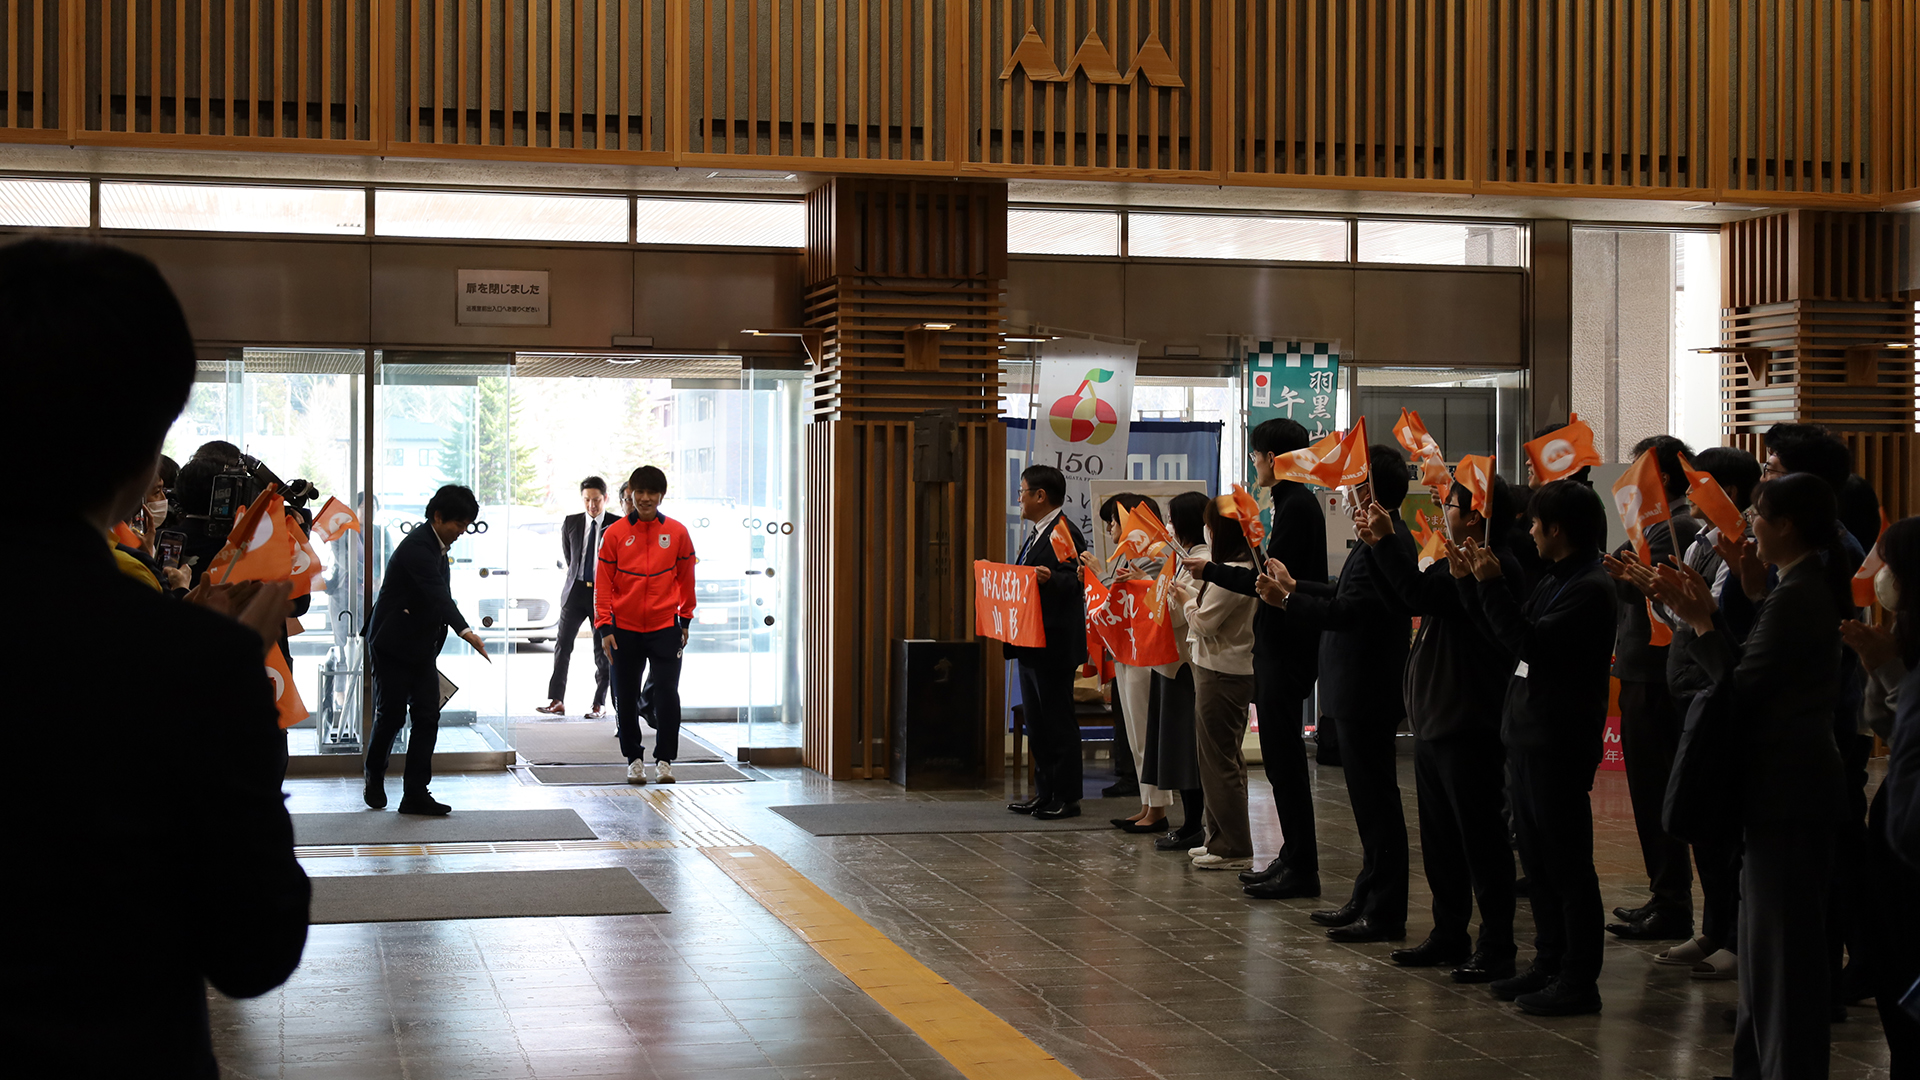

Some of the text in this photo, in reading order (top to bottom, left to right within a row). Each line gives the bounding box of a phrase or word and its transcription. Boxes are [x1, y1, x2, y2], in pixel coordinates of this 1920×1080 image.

[466, 283, 539, 295] 扉を閉じました
[1308, 370, 1334, 442] 羽黒山
[981, 569, 1029, 604] がんばれ!
[992, 605, 1019, 641] 山形
